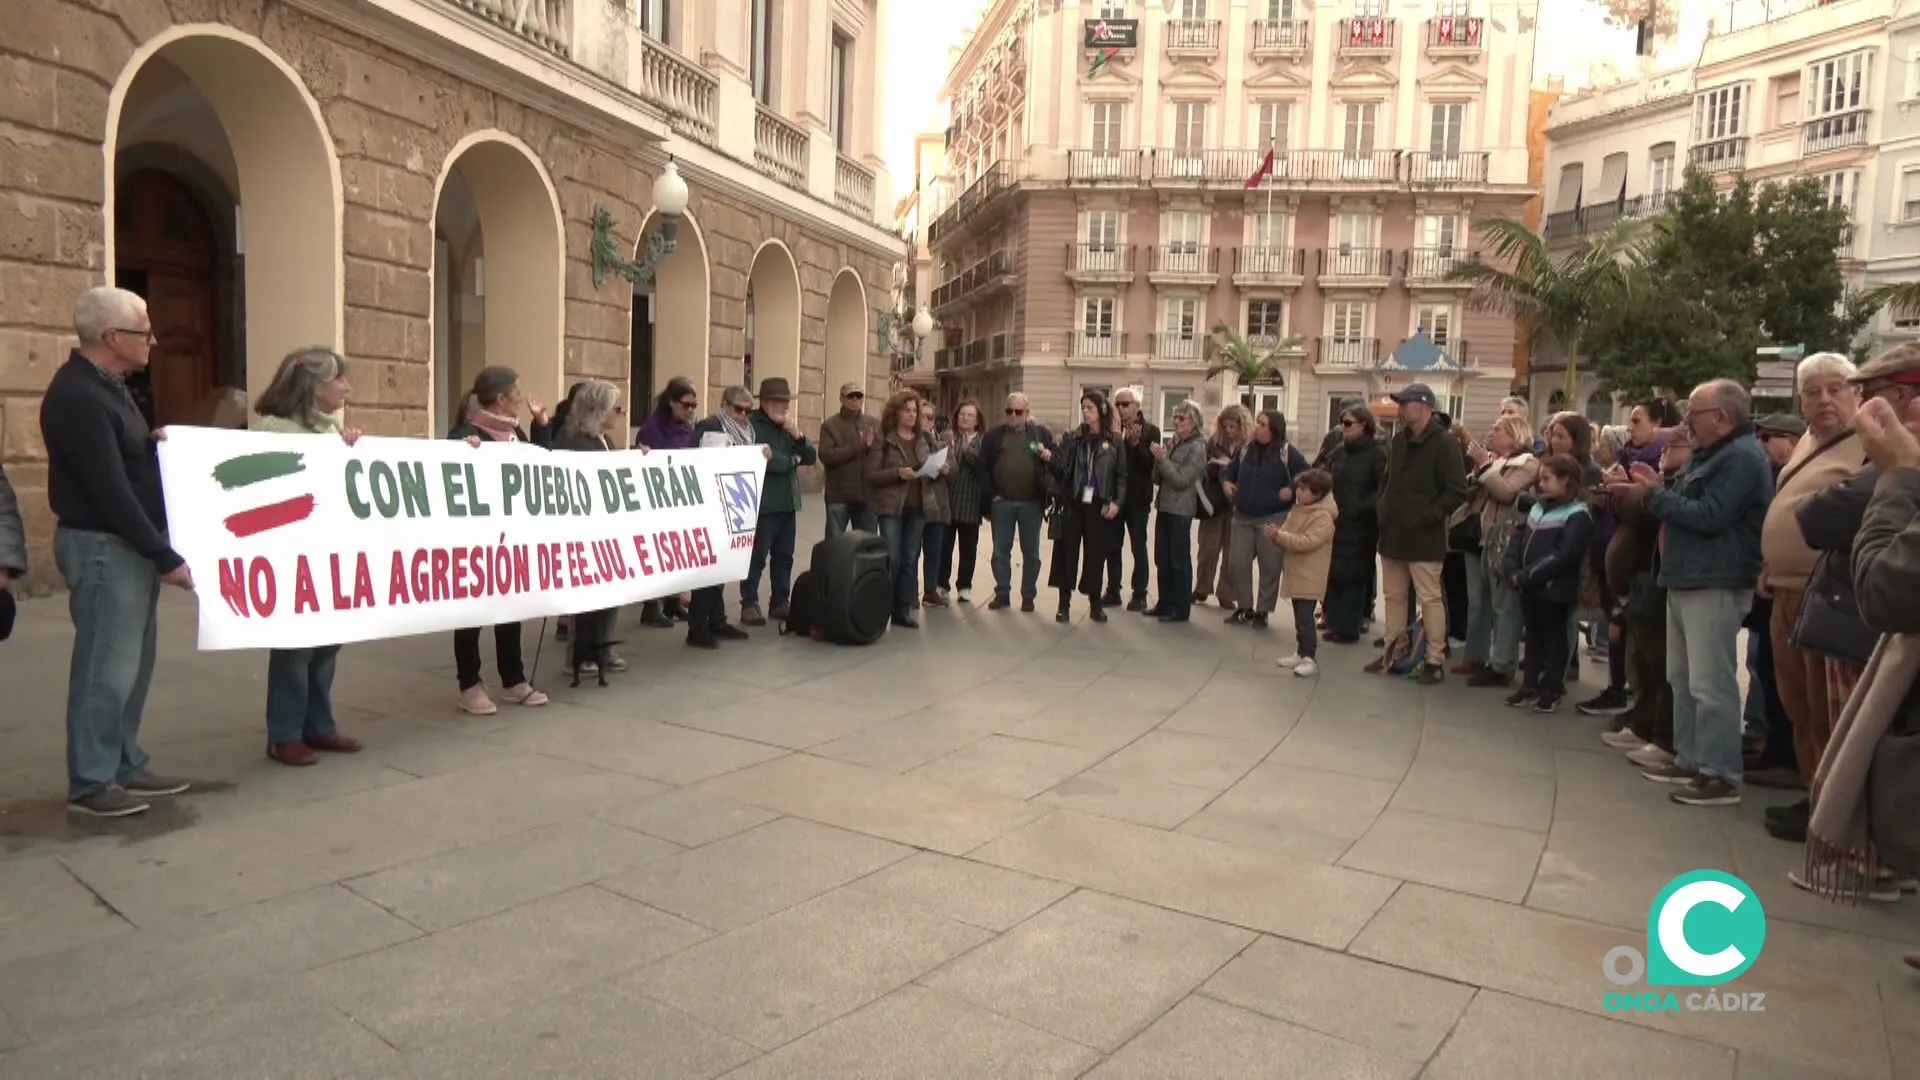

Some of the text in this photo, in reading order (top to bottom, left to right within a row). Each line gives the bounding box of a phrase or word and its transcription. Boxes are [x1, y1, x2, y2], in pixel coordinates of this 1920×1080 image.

[345, 459, 431, 519] CON
[441, 463, 490, 516] EL
[501, 463, 592, 516] PUEBLO
[598, 467, 641, 514] DE
[642, 456, 704, 509] IRÁN
[218, 527, 717, 618] NO A LA AGRESIÓN DE EE.UU. E ISRAEL
